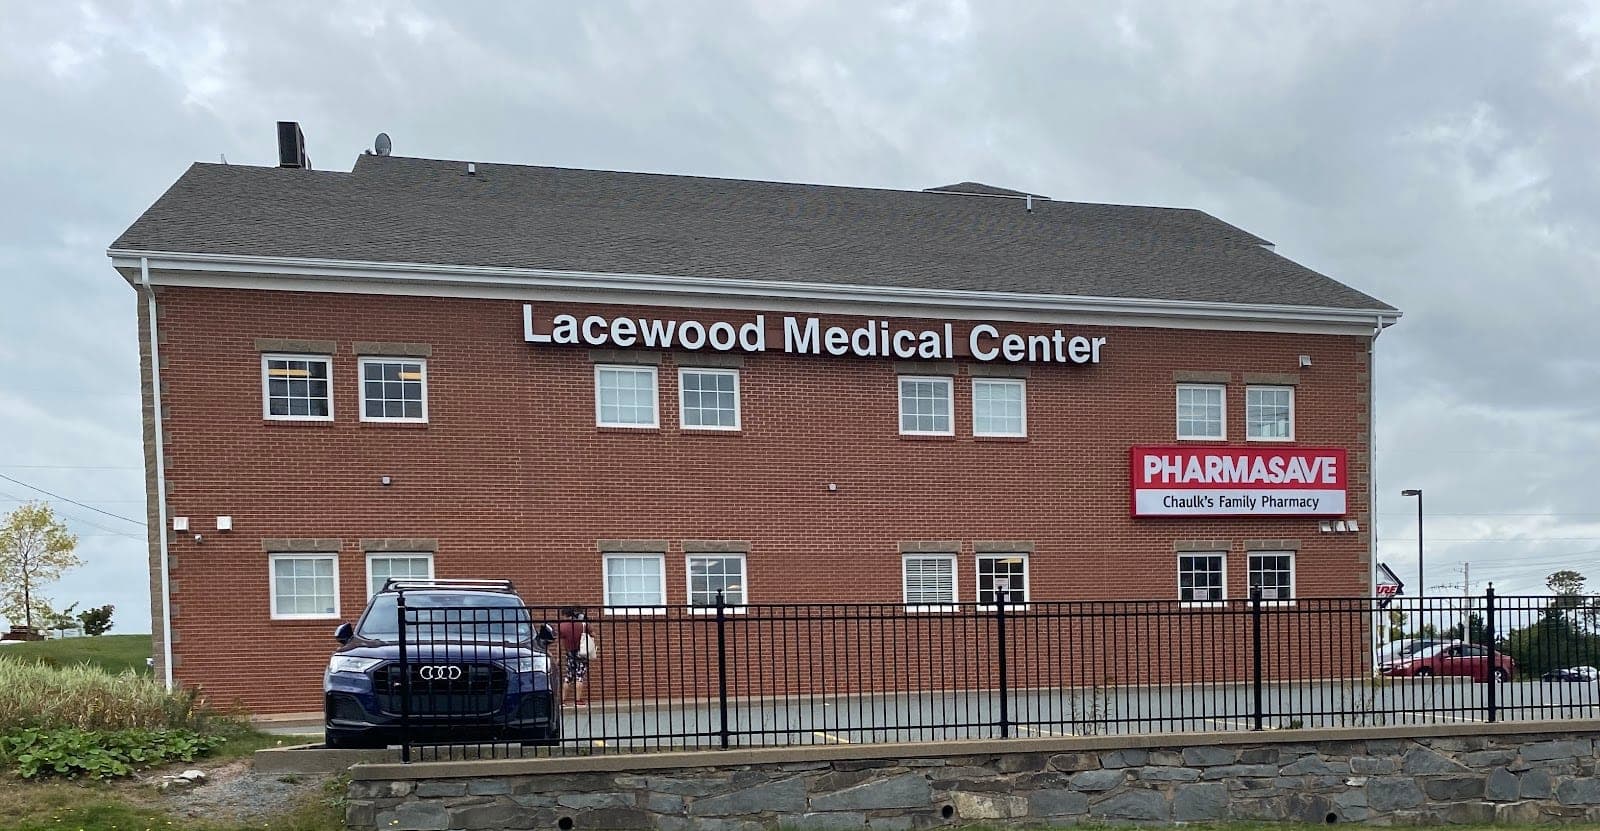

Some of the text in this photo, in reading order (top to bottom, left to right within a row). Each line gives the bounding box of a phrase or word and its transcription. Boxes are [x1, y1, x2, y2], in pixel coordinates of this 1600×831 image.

[523, 304, 1107, 364] Lacewood Medical Center
[1143, 455, 1337, 484] PHARMASAVE
[1163, 495, 1320, 511] Chaulk's Family Pharmacy
